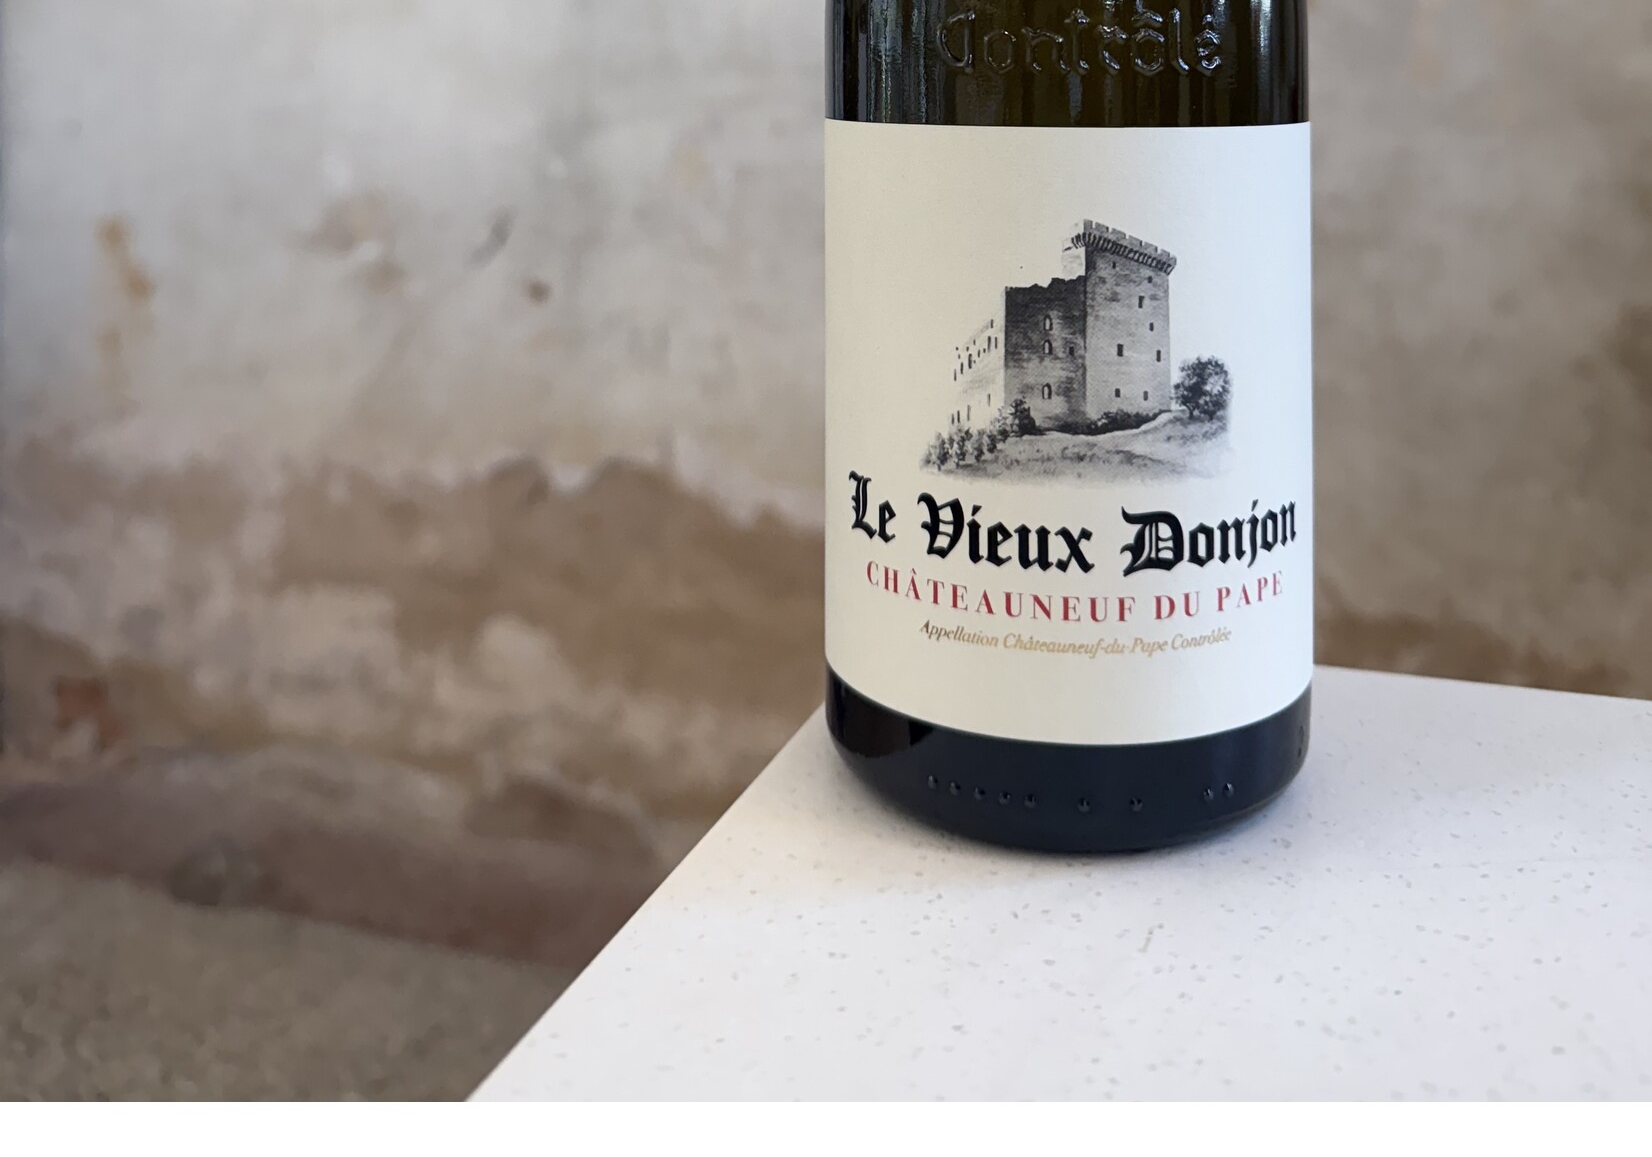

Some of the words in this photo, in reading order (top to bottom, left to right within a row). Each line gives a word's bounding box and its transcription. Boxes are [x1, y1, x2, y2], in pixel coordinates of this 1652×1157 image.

[848, 469, 897, 544] Le
[916, 491, 1096, 574] Vieux
[1121, 498, 1297, 577] Donjon
[866, 560, 1136, 623] CHÂTEAUNEUF
[1154, 591, 1201, 620] DU
[1216, 569, 1284, 613] PAPE
[919, 618, 1000, 648] Appellation
[1171, 625, 1233, 651] Contrôlée
